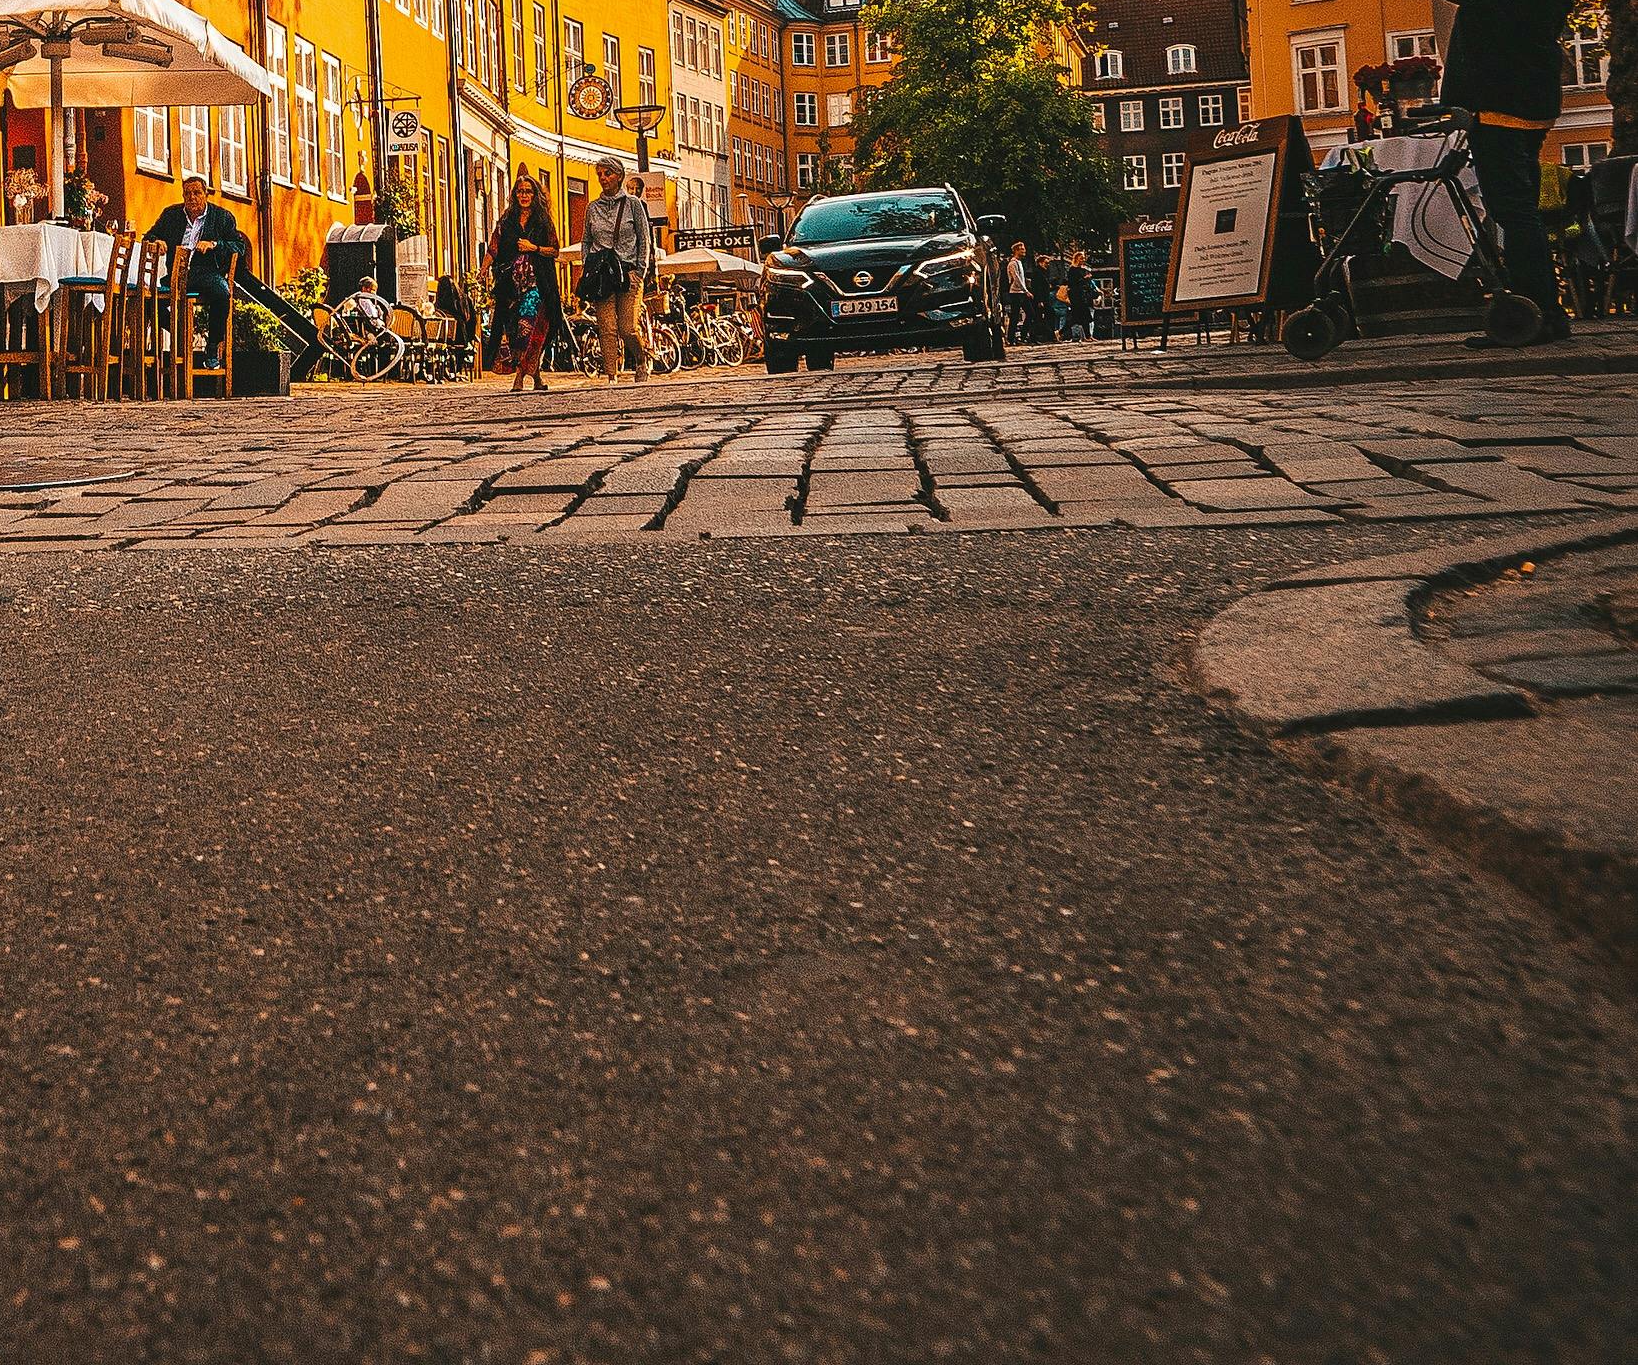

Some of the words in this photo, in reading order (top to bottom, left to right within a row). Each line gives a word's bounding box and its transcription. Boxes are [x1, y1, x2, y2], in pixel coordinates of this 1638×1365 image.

[1213, 122, 1262, 150] Coca-Cola
[679, 237, 722, 250] PEDER
[724, 235, 751, 247] OXE
